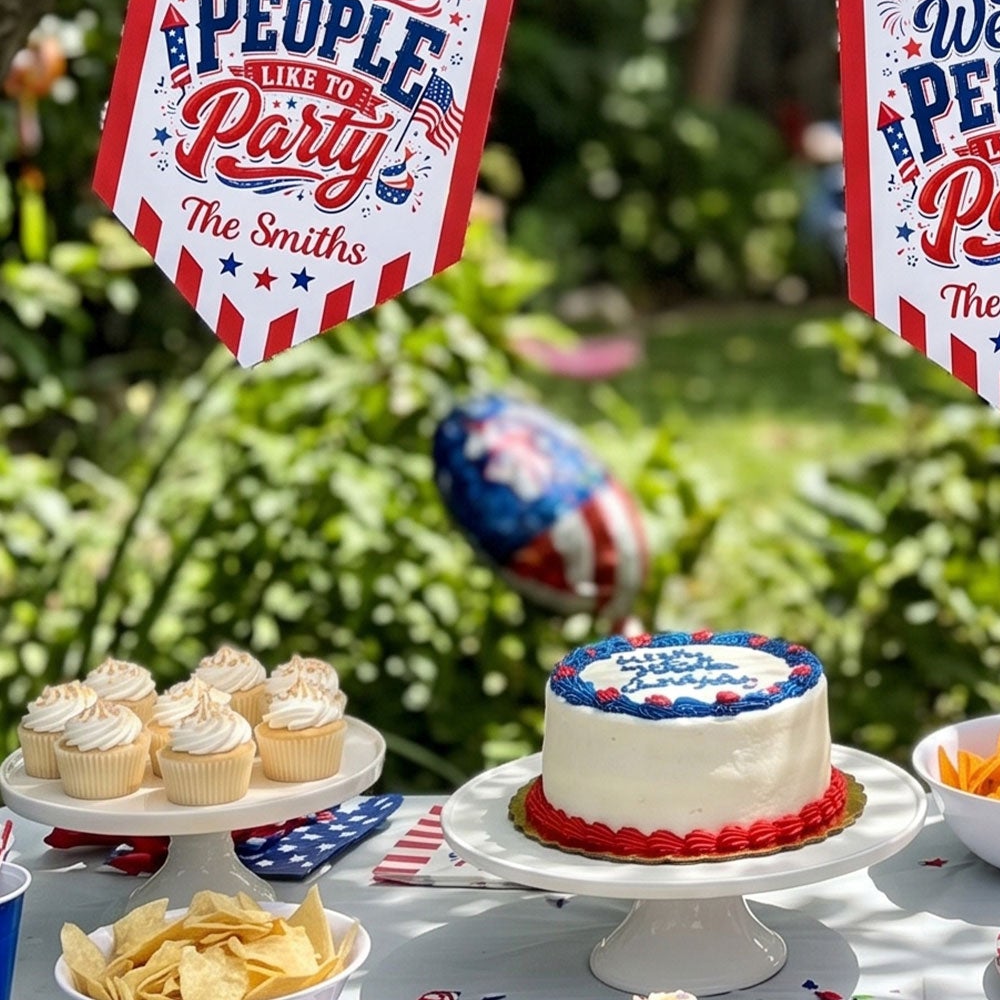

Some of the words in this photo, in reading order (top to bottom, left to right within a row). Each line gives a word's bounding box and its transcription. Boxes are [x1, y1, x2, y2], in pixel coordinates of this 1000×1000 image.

[260, 65, 314, 91] LIKE
[326, 74, 353, 99] TO
[175, 78, 394, 211] Party
[182, 196, 240, 240] The
[251, 211, 368, 264] Smiths
